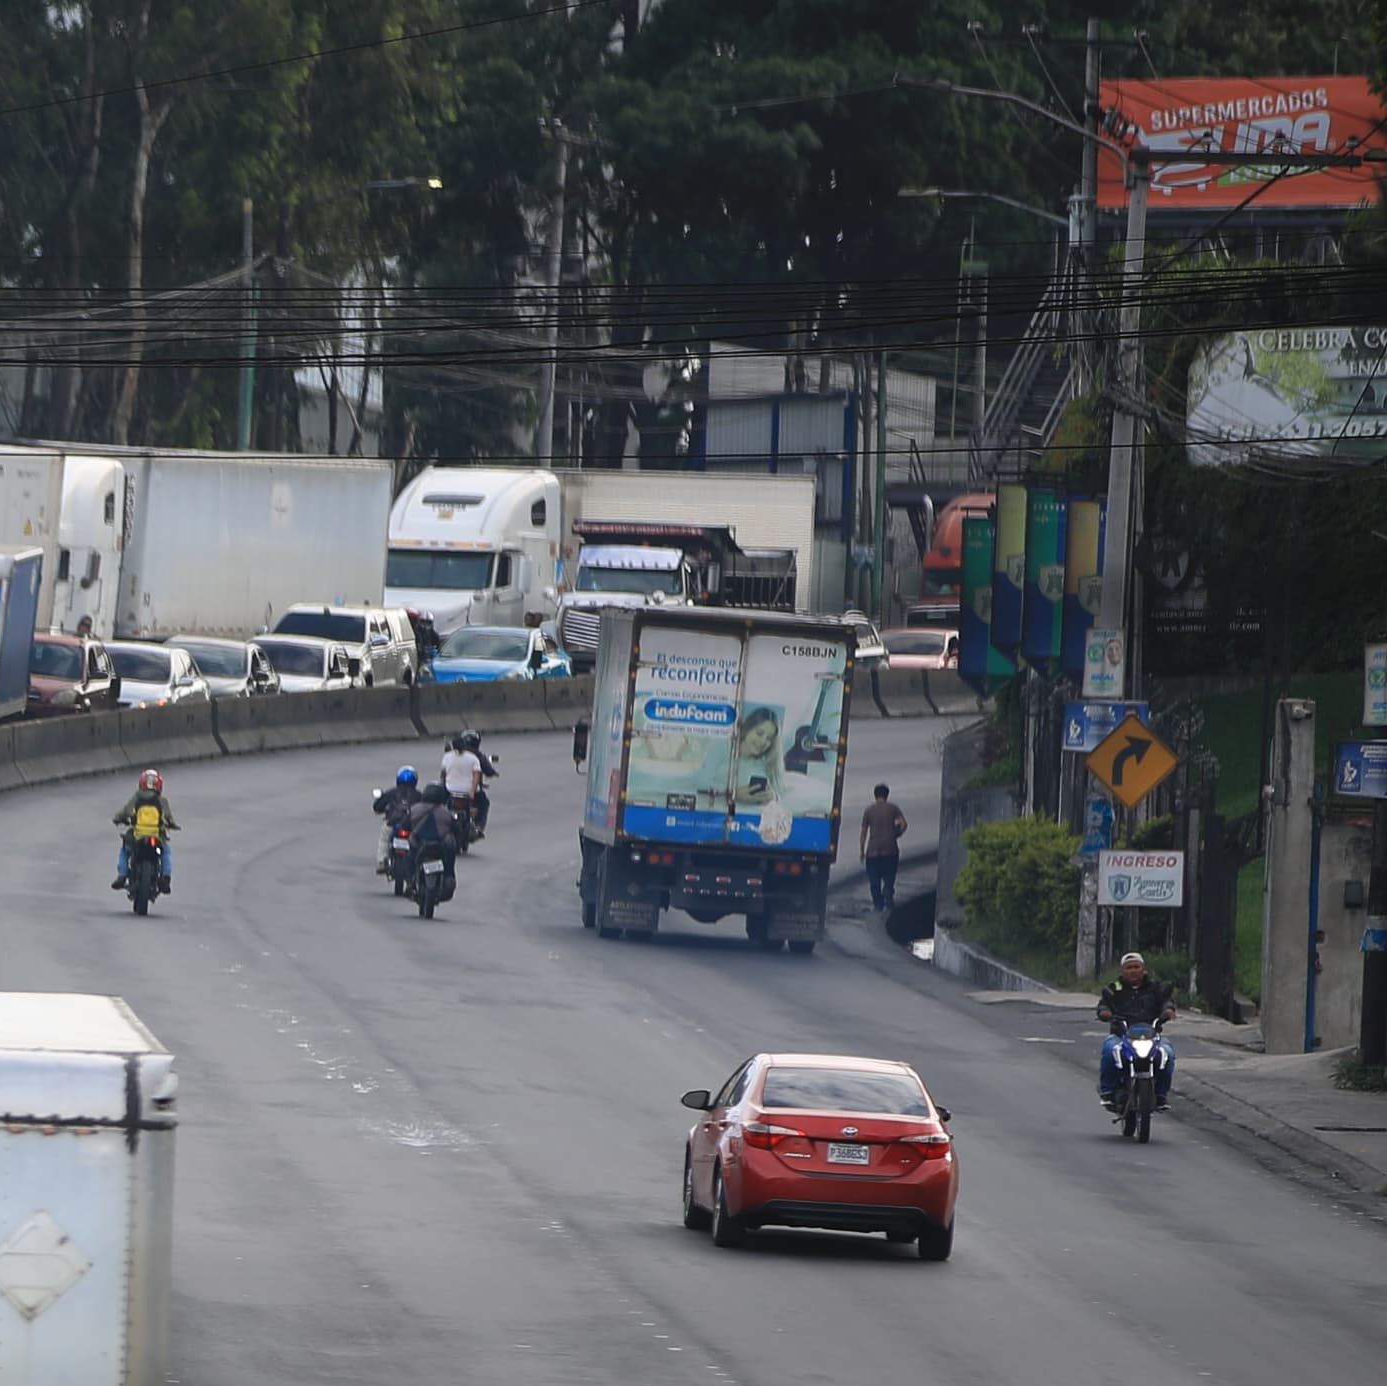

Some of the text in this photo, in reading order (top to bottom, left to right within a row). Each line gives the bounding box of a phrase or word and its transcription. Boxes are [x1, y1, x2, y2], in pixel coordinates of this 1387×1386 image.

[1150, 87, 1328, 131] SUPERMERCADOS
[1258, 328, 1357, 350] CELEBRA
[782, 646, 837, 659] C158BJN
[718, 659, 737, 669] que
[651, 666, 741, 686] reconforta
[1107, 856, 1178, 868] INGRESO
